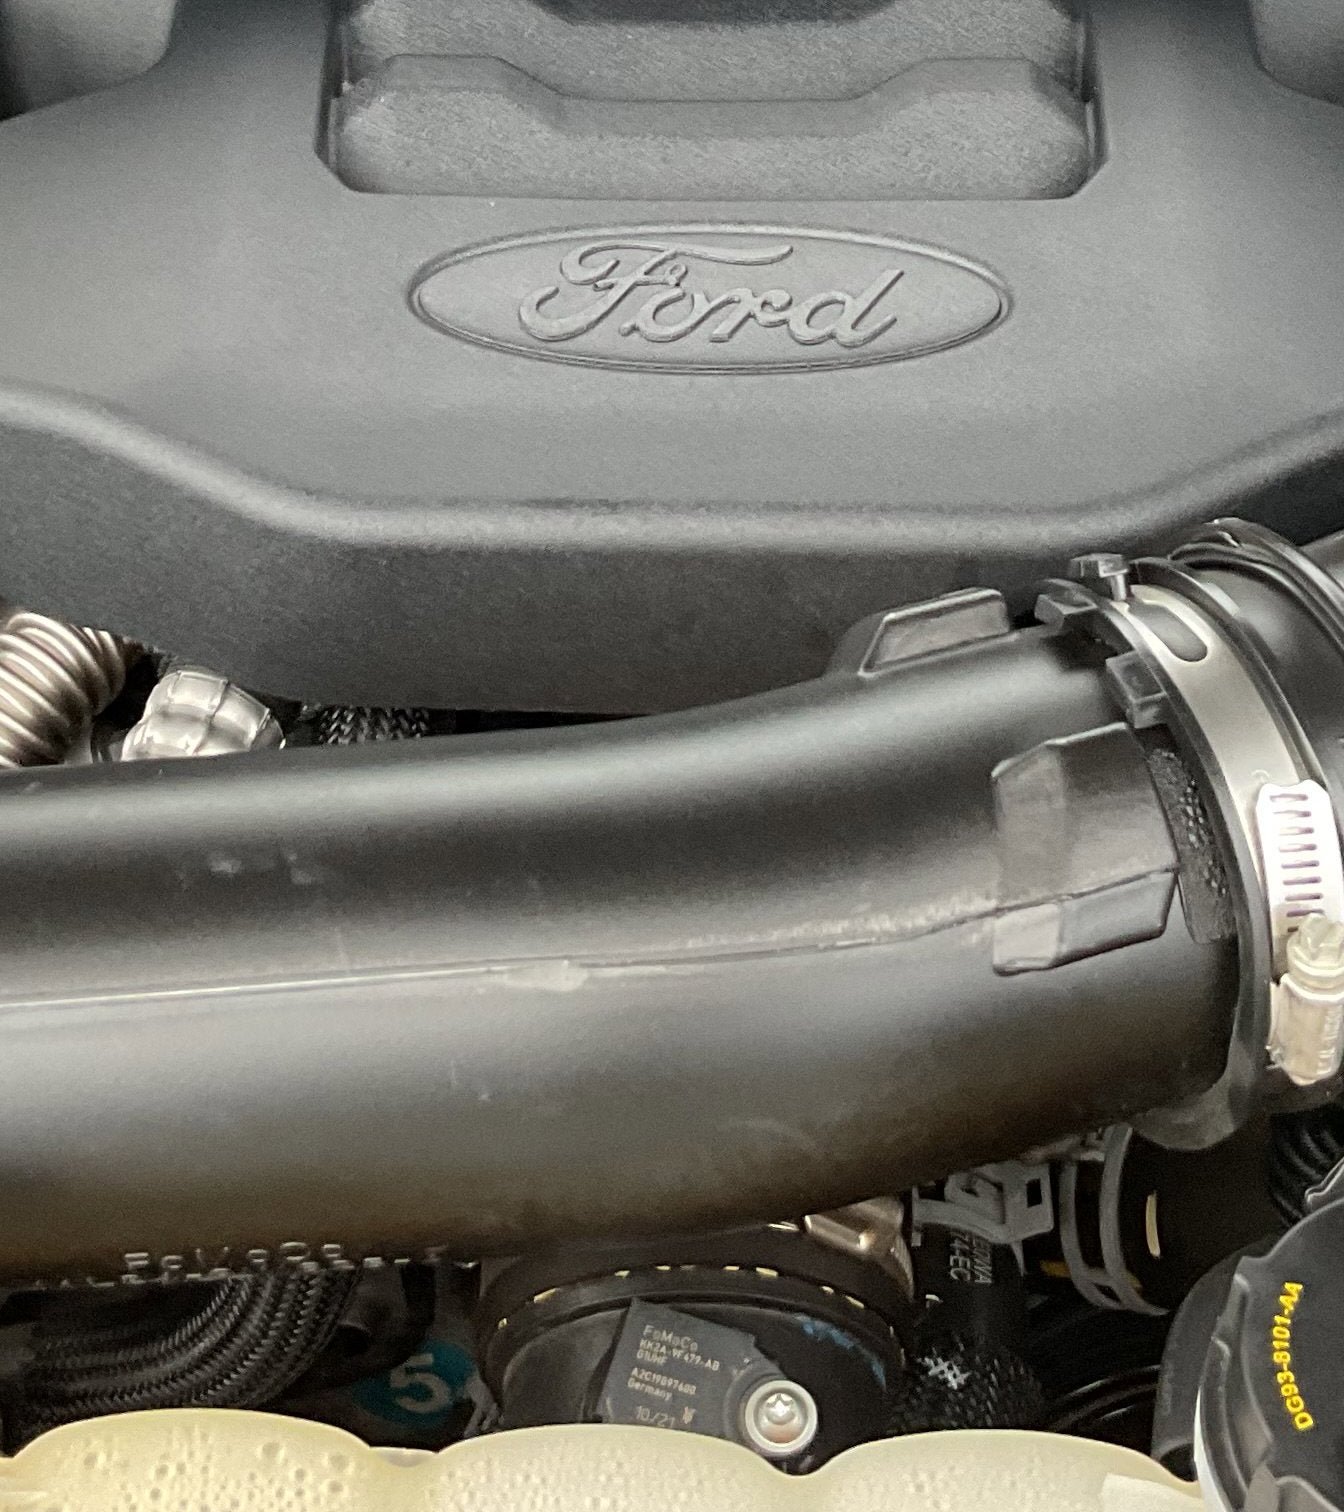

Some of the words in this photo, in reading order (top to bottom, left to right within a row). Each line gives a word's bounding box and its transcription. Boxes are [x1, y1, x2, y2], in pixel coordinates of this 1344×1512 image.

[519, 240, 905, 348] Ford
[390, 1353, 450, 1414] 5
[1272, 1282, 1314, 1431] DG93-8101-AA
